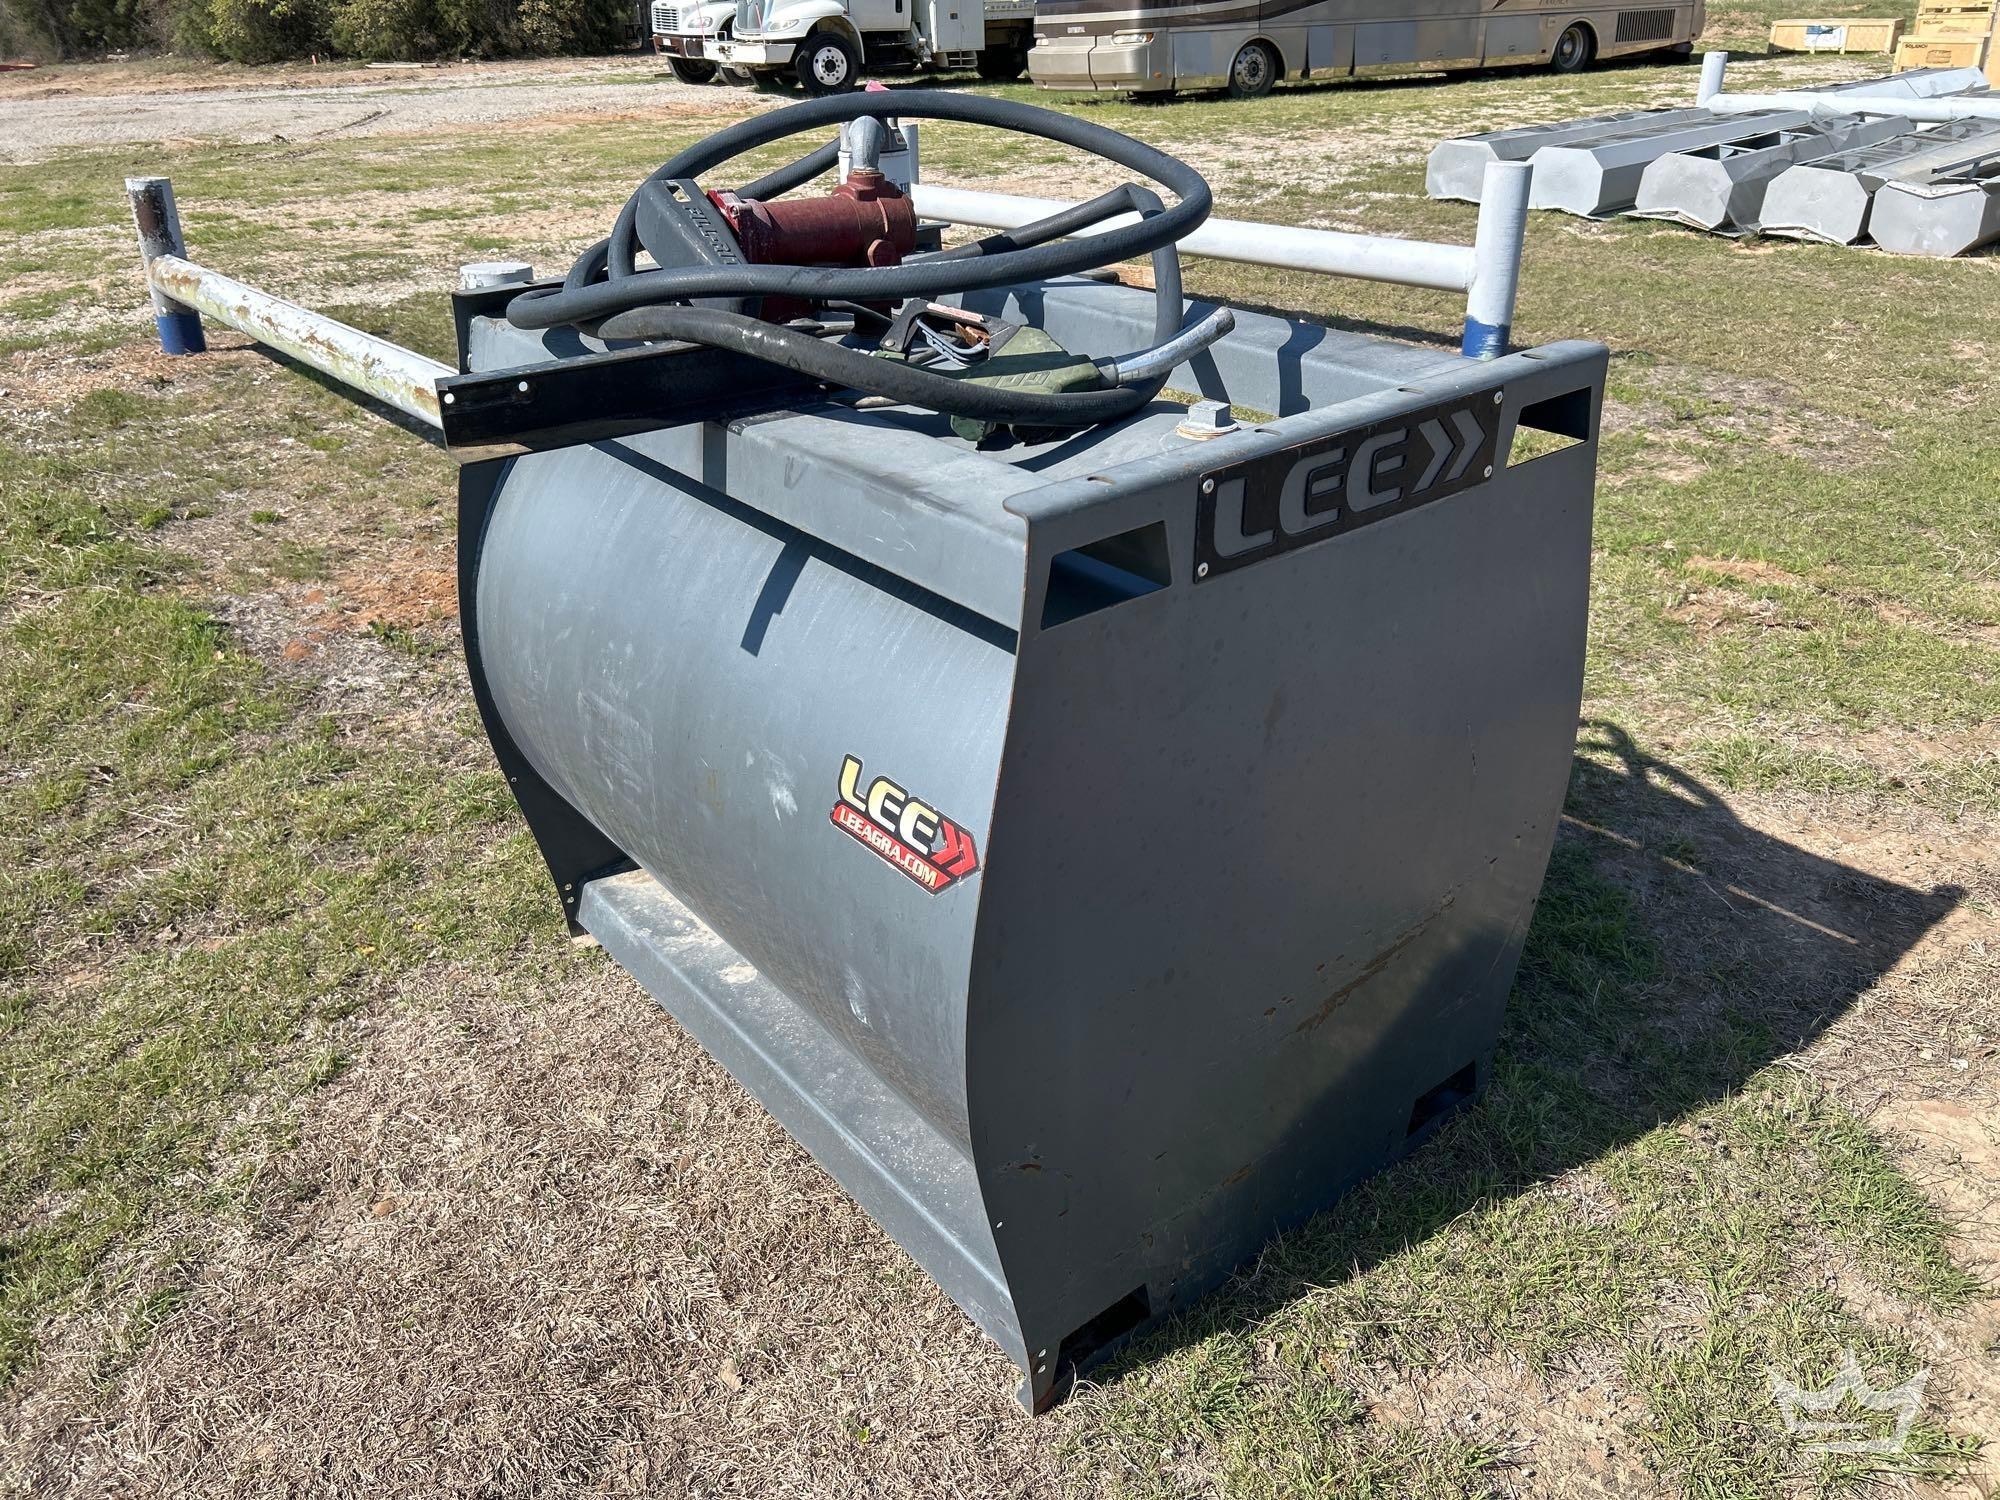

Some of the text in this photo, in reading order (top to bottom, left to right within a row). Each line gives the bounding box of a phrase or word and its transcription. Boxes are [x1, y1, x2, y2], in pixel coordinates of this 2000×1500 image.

[1213, 424, 1409, 559] LEE
[839, 757, 940, 856] LEE
[839, 807, 938, 888] LEEAGRA.COM
